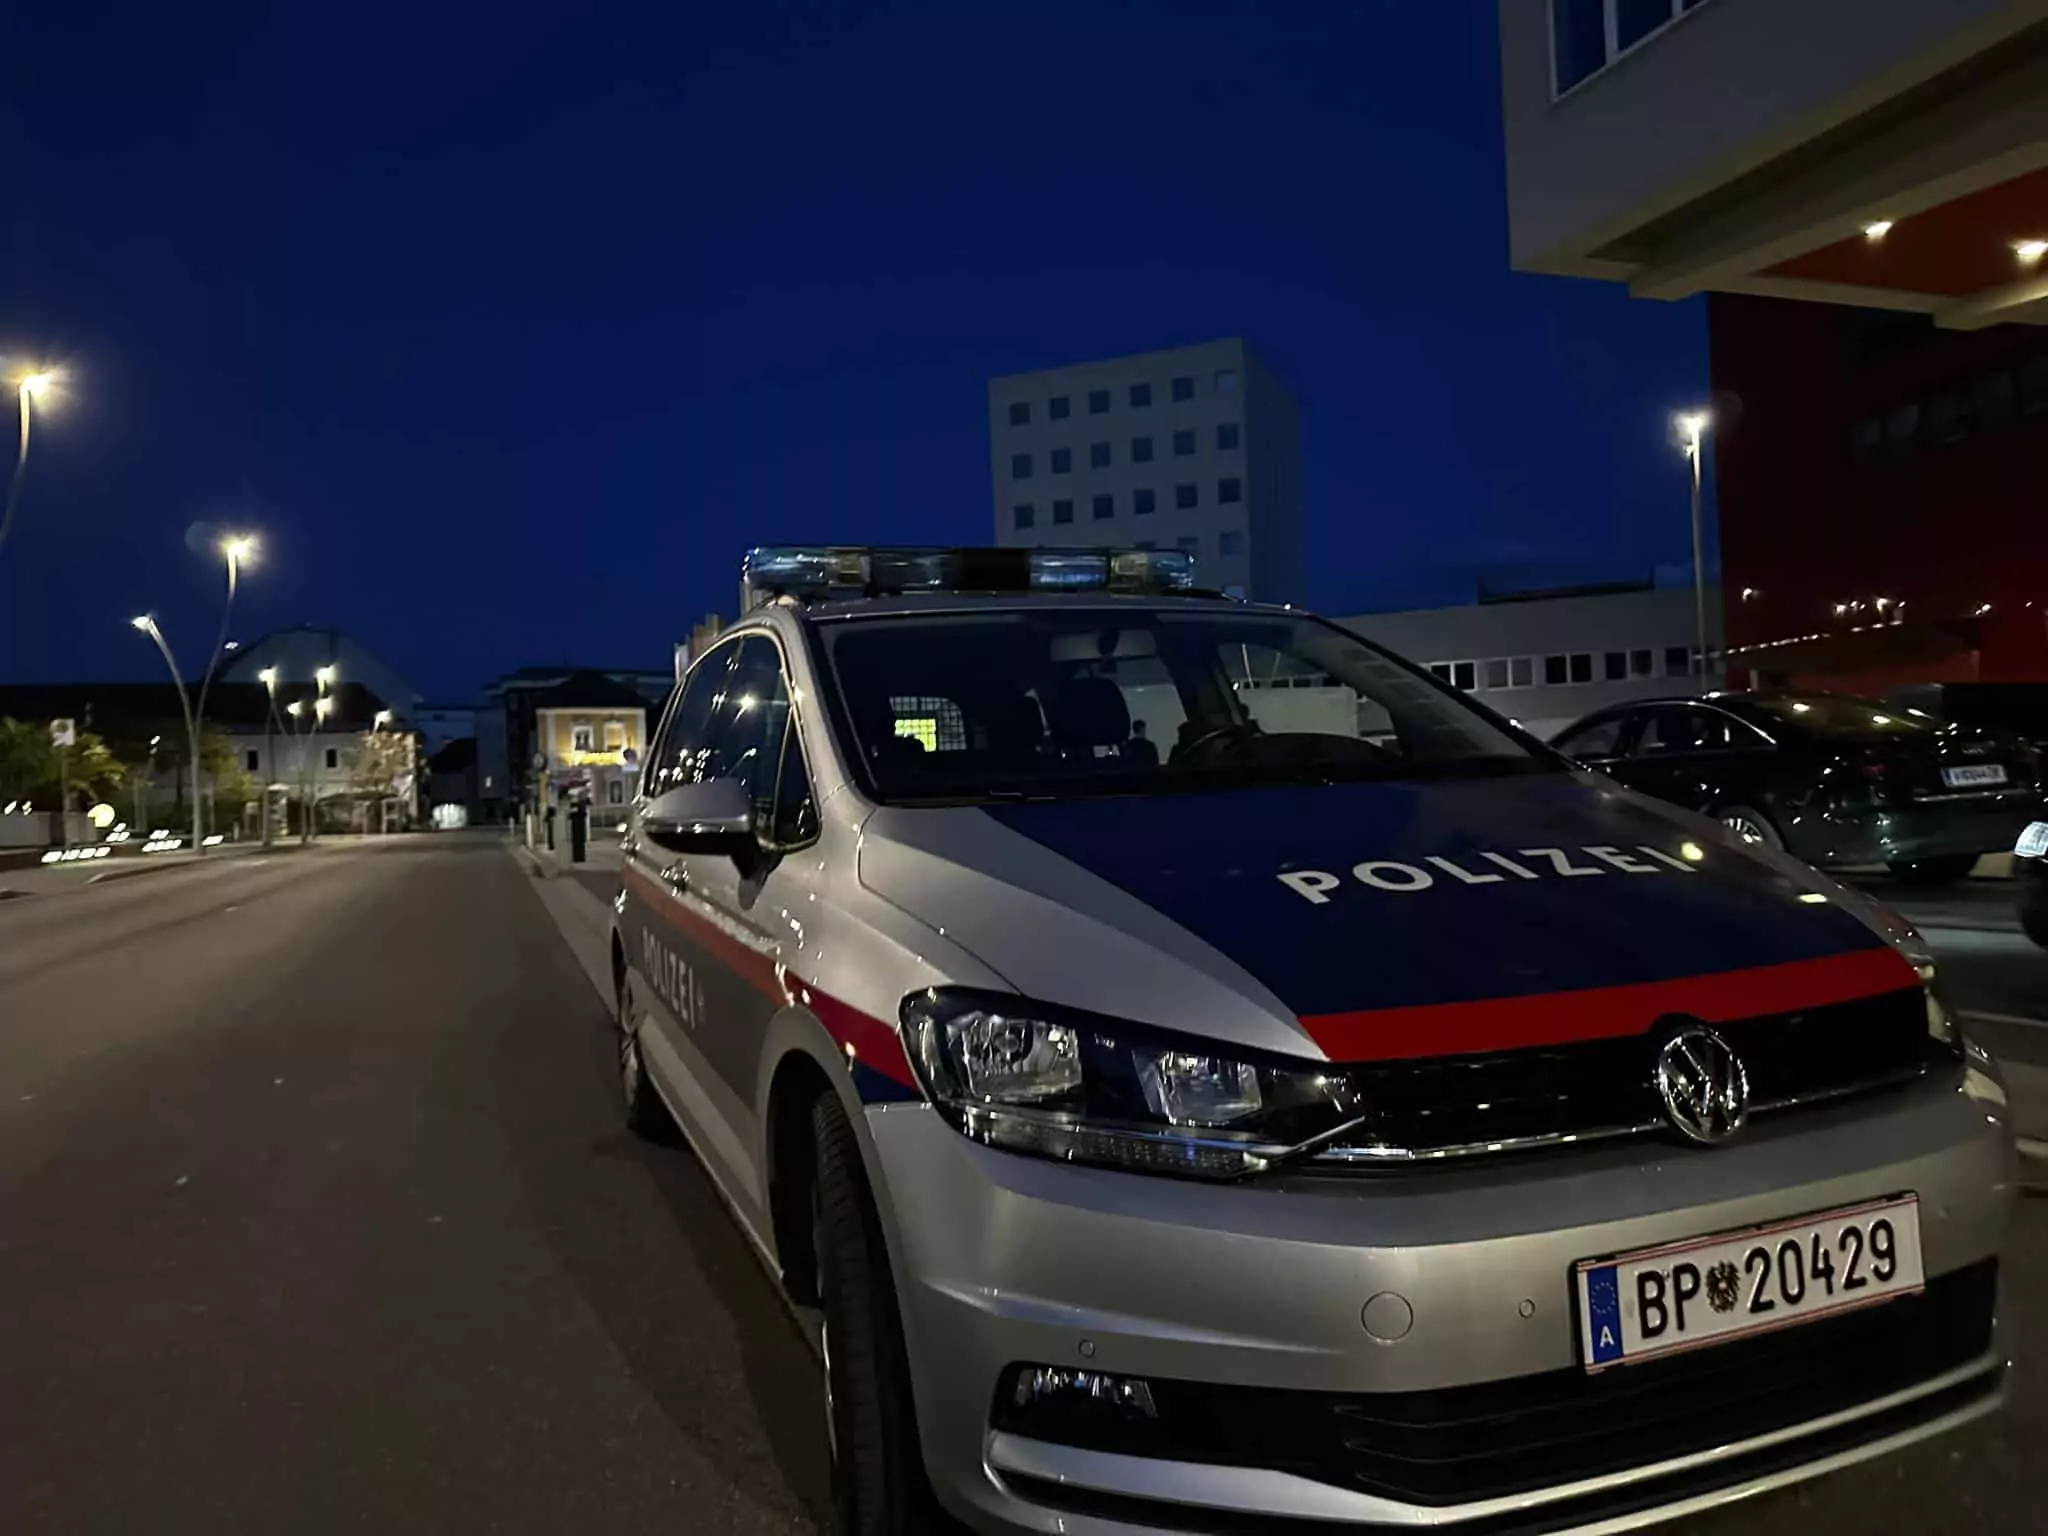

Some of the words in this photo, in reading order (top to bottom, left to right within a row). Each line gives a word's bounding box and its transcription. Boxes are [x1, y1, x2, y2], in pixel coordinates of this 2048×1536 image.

[1276, 845, 1698, 905] POLIZEI
[641, 925, 696, 1031] POLIZEI
[1636, 1263, 1700, 1338] BP
[1744, 1218, 1896, 1314] 20429
[1599, 1325, 1615, 1348] A
